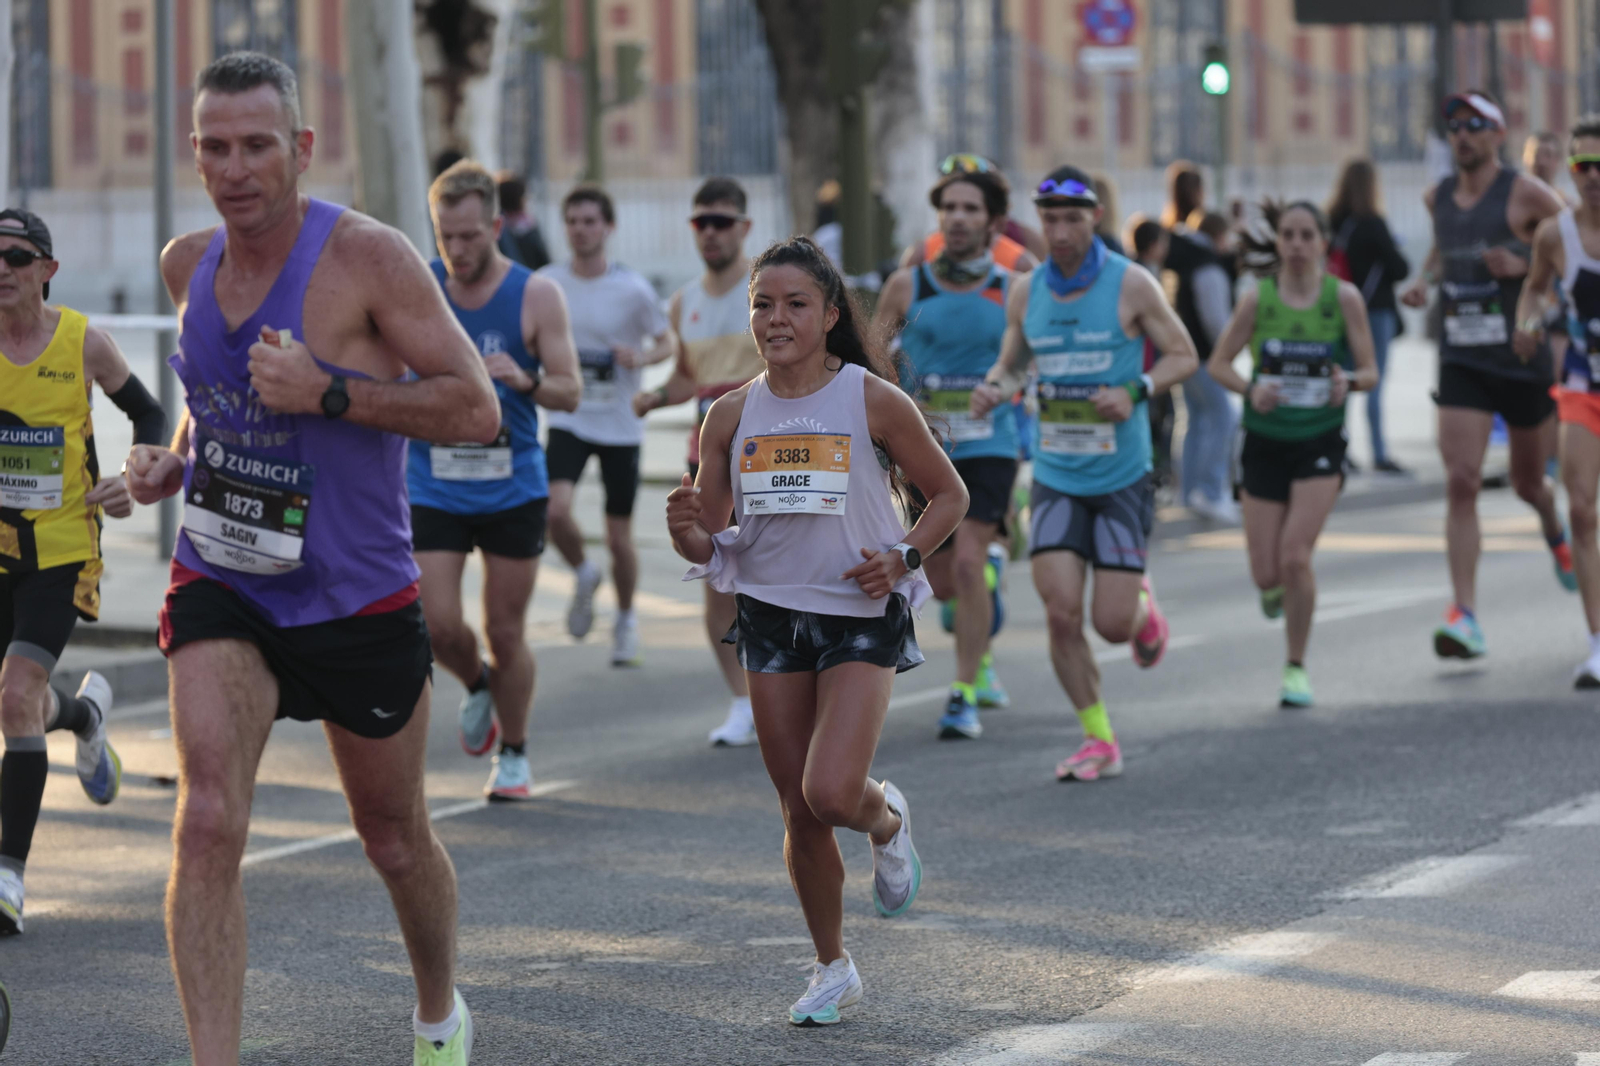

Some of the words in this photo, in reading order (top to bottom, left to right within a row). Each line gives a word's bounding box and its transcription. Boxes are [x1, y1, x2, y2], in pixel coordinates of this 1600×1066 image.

[0, 430, 54, 444] ZURICH
[2, 456, 30, 470] 1051
[773, 448, 810, 464] 3383
[226, 453, 300, 485] ZURICH
[771, 474, 811, 487] GRACE
[224, 491, 264, 520] 1873
[220, 522, 258, 546] SAGIV
